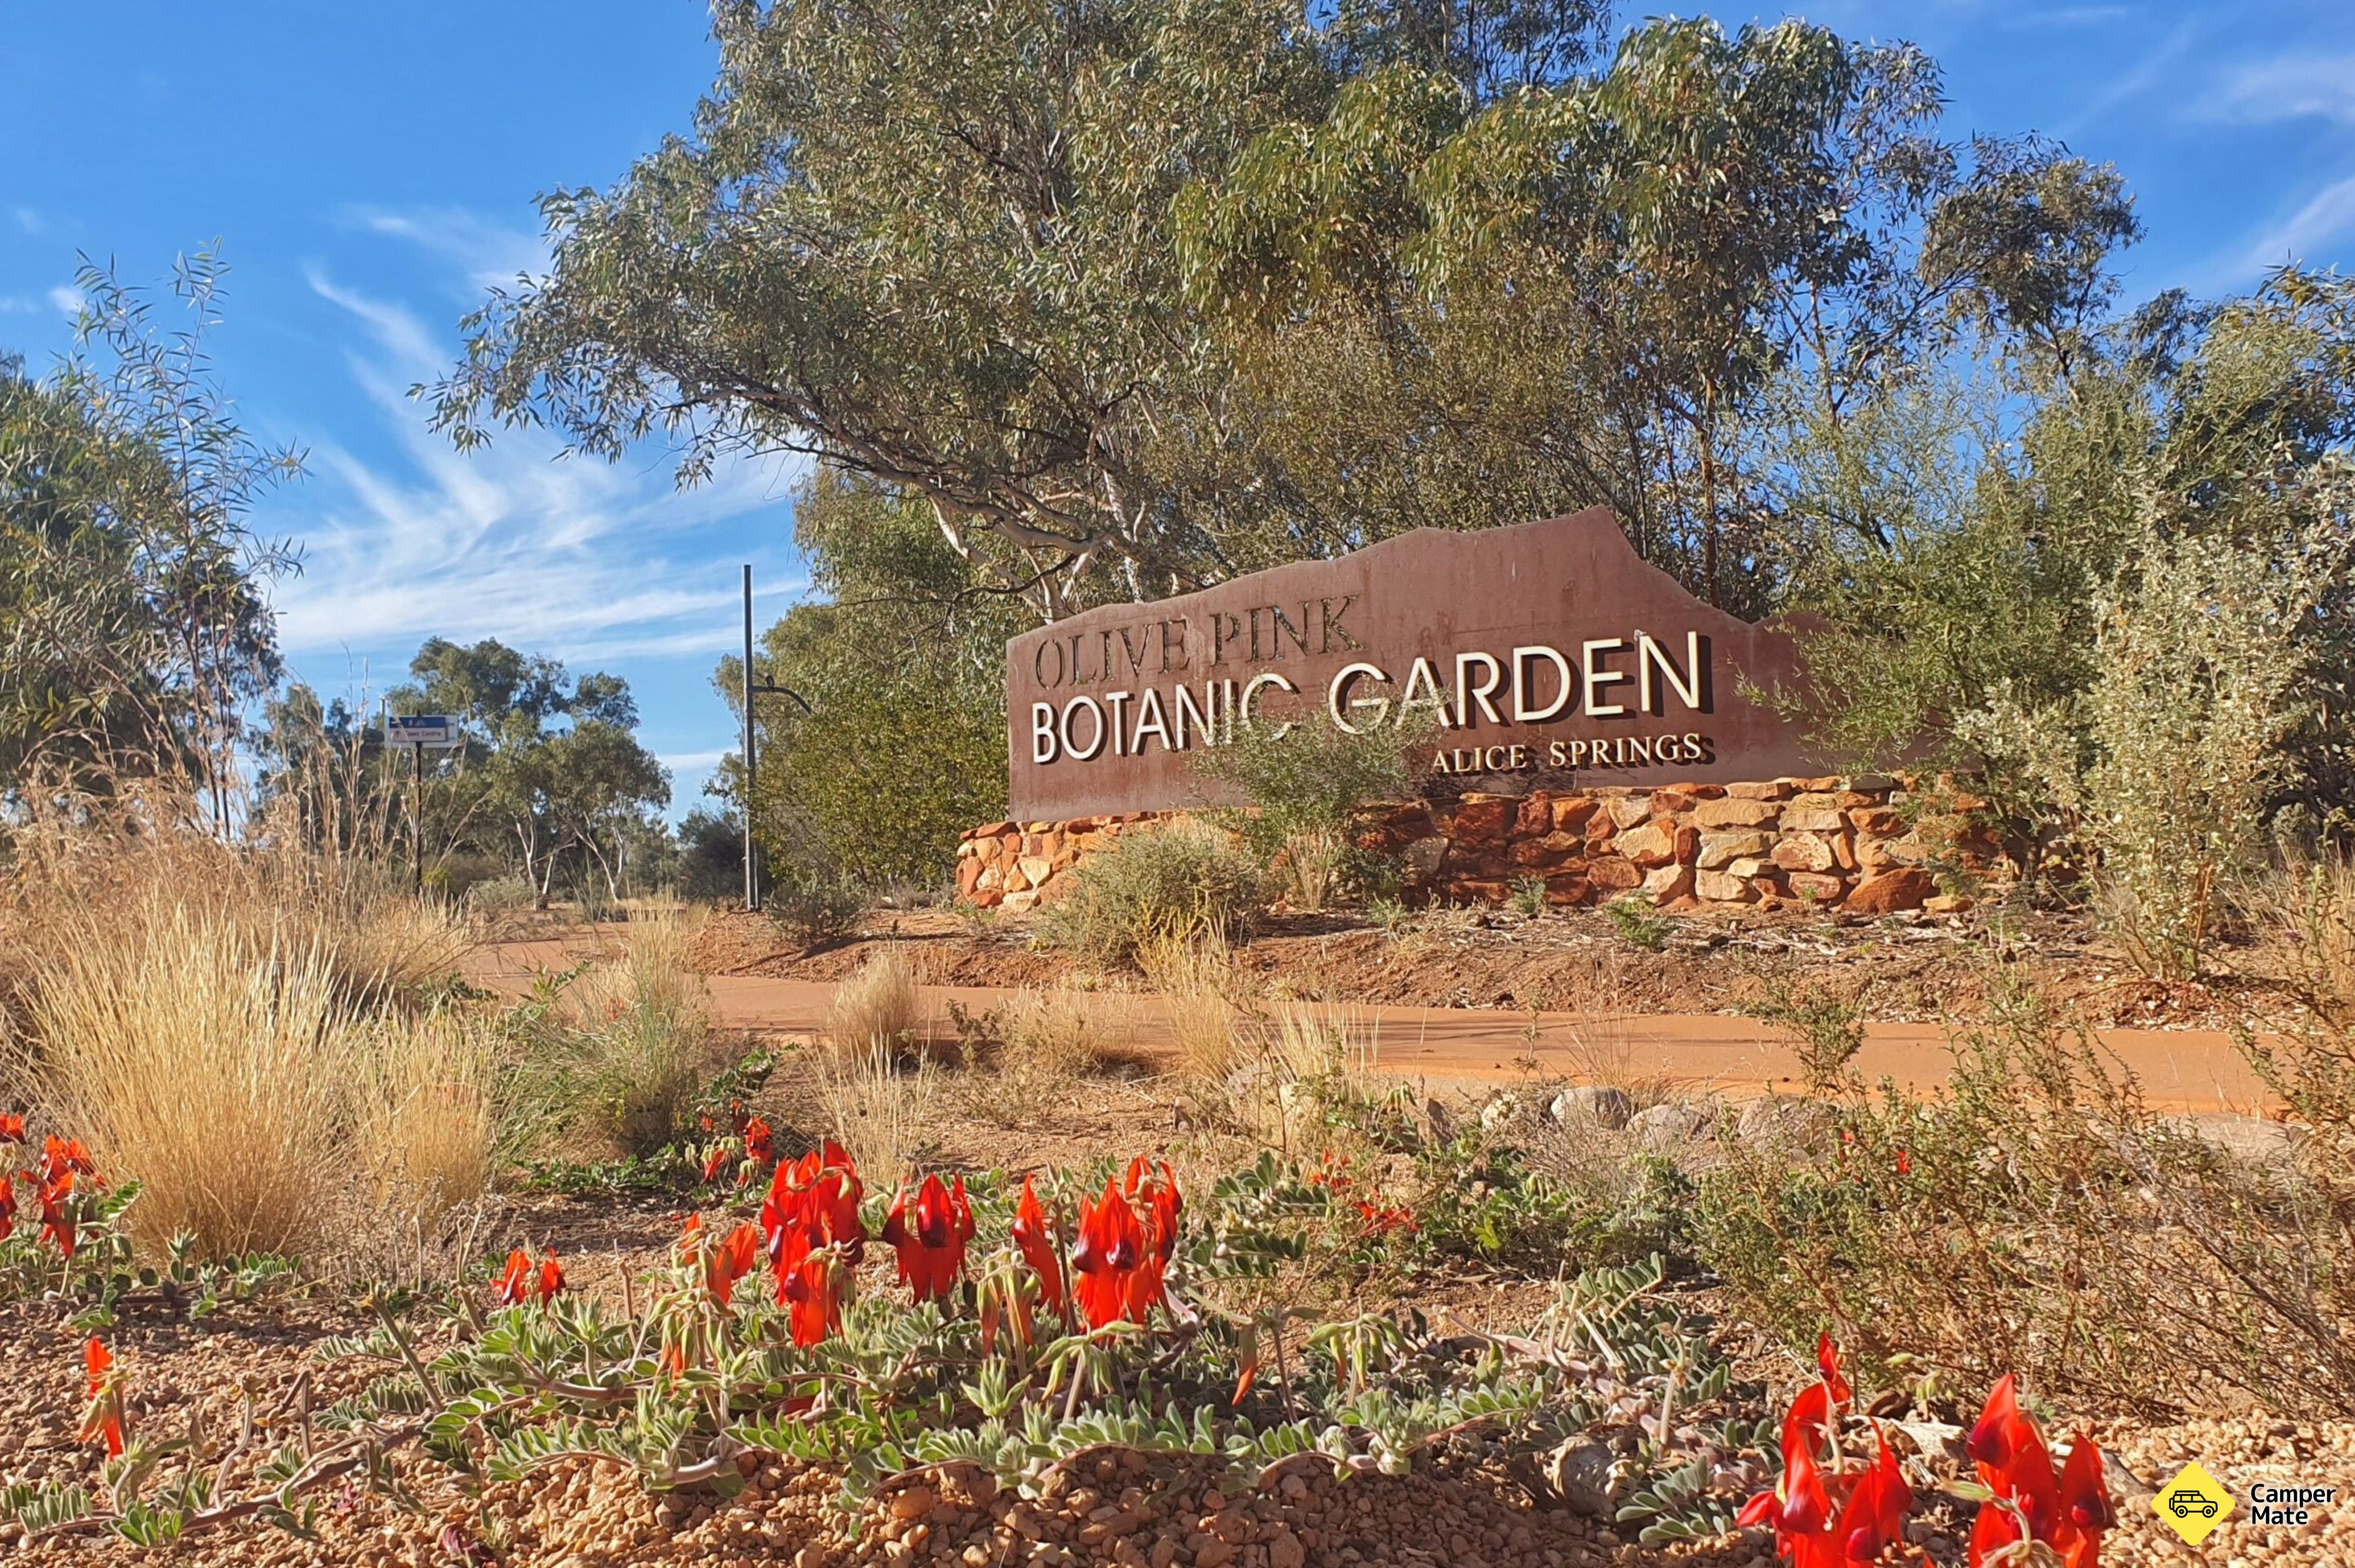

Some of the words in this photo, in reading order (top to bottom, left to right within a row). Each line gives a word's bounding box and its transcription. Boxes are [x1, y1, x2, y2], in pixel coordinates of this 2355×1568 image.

[1036, 619, 1190, 690] OLIVE
[1209, 594, 1364, 667] PINK
[1032, 673, 1293, 763] BOTANIC
[1328, 631, 1700, 735] GARDEN
[1432, 744, 1527, 774] ALICE
[1550, 733, 1703, 766] SPRINGS
